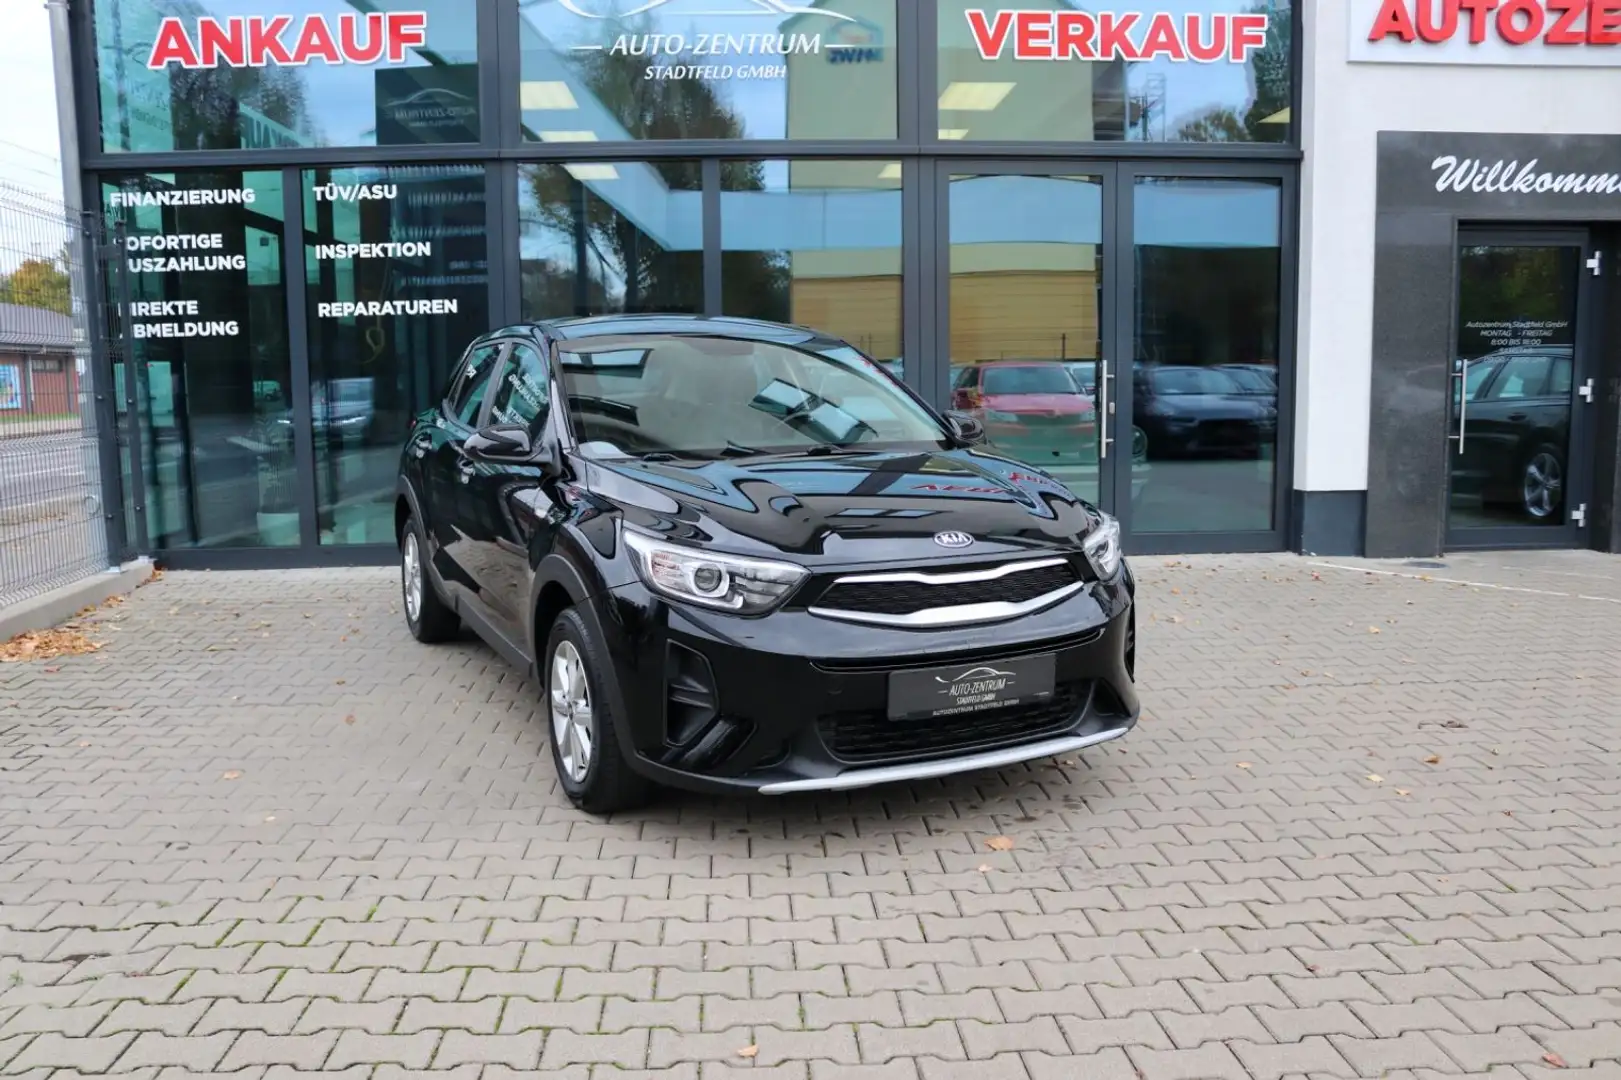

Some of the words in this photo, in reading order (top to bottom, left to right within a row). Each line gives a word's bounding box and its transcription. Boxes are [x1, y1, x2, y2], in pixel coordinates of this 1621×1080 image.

[149, 12, 426, 68] ANKAUF
[609, 32, 821, 56] AUTO-ZENTRUM
[967, 10, 1267, 62] VERKAUF
[644, 65, 733, 80] STADTFELD
[736, 64, 788, 79] GMBH
[1431, 155, 1621, 194] Willkomm
[109, 187, 256, 208] FINANZIERUNG
[312, 182, 397, 202] TÜV/ASU
[113, 233, 223, 251] OFORTIGE
[315, 241, 431, 260] INSPEKTION
[115, 254, 246, 273] USZAHLUNG
[117, 300, 199, 317] IREKTE
[318, 298, 458, 318] REPARATUREN
[119, 320, 239, 340] BMELDUNG
[940, 533, 969, 544] KIA
[949, 678, 1007, 696] AUTO-ZENTRUM
